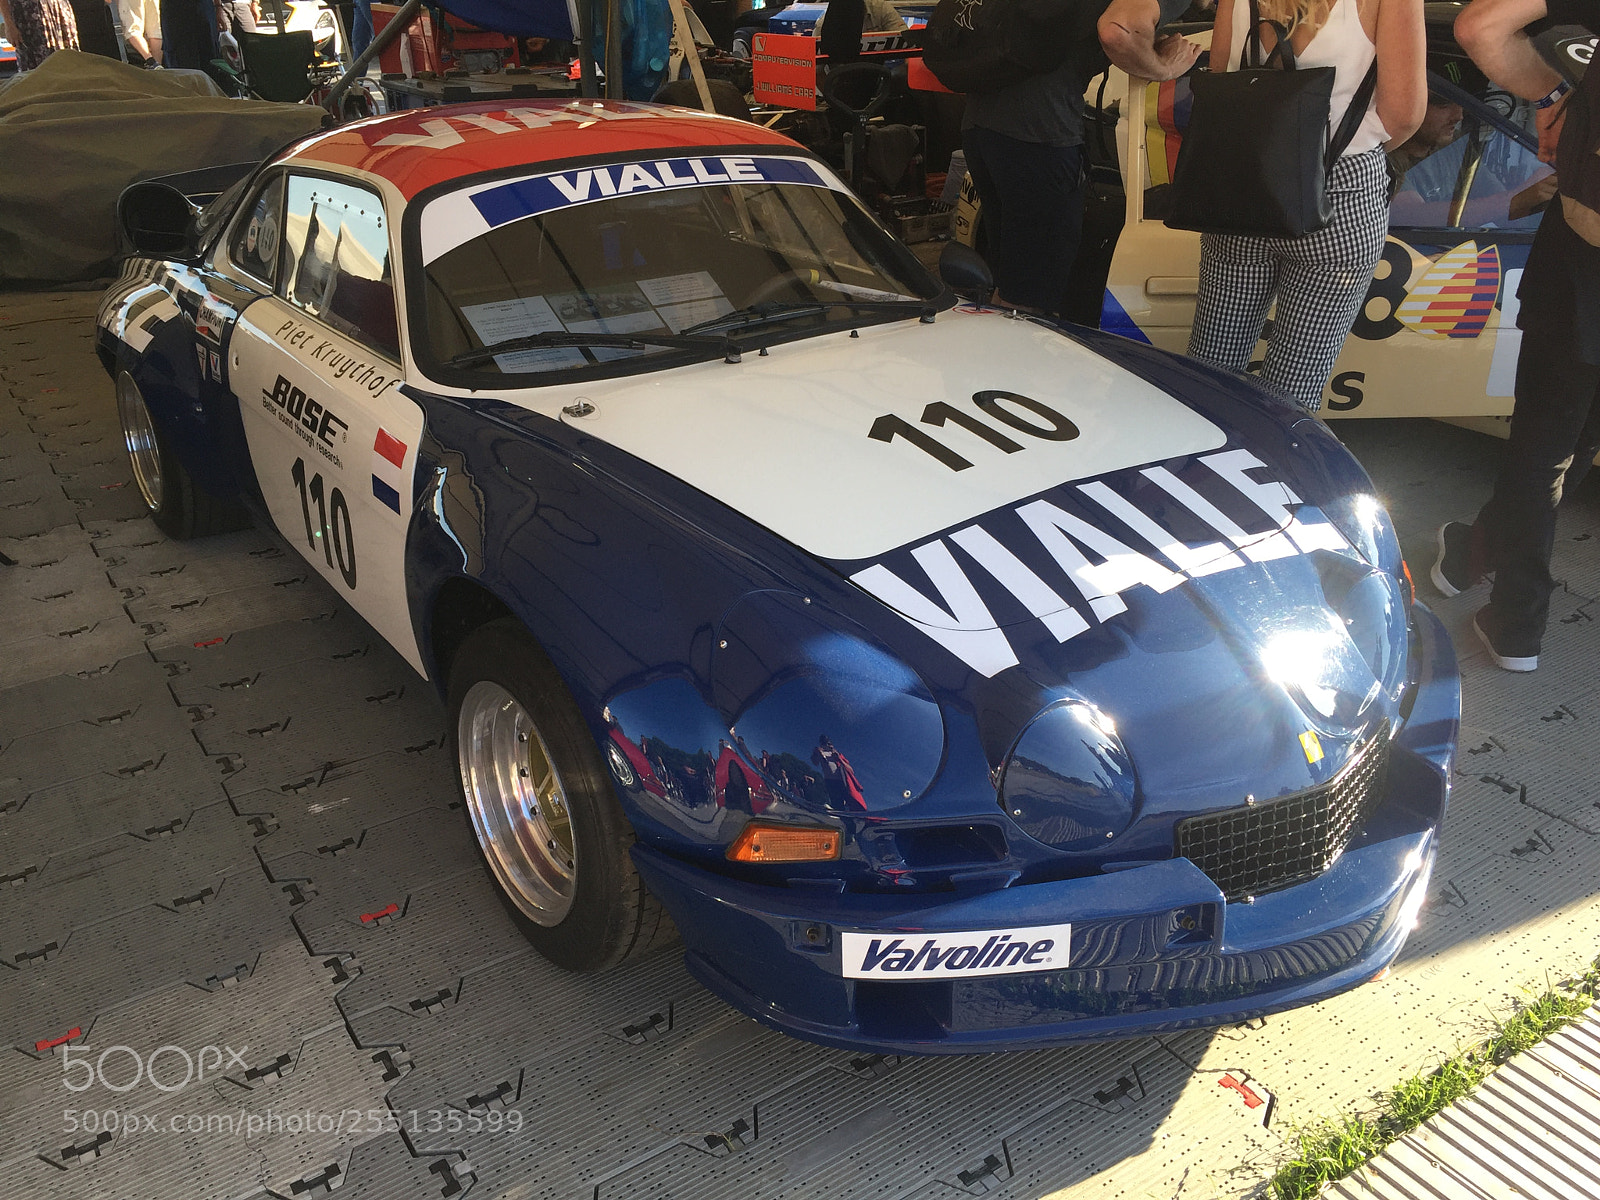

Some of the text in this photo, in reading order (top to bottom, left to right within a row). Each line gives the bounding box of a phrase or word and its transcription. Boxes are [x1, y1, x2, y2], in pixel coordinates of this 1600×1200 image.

[753, 54, 812, 68] COMPUTERVISION
[794, 86, 814, 99] CARS
[548, 158, 764, 202] VIALLE
[275, 320, 401, 399] Piet Kruythof
[262, 374, 348, 447] BOSE
[262, 397, 277, 417] Better
[278, 411, 293, 430] sound
[294, 423, 315, 448] through
[867, 389, 1080, 473] 110
[291, 457, 357, 590] 110
[849, 449, 1350, 678] VIALLE
[860, 934, 1055, 972] Valvoline
